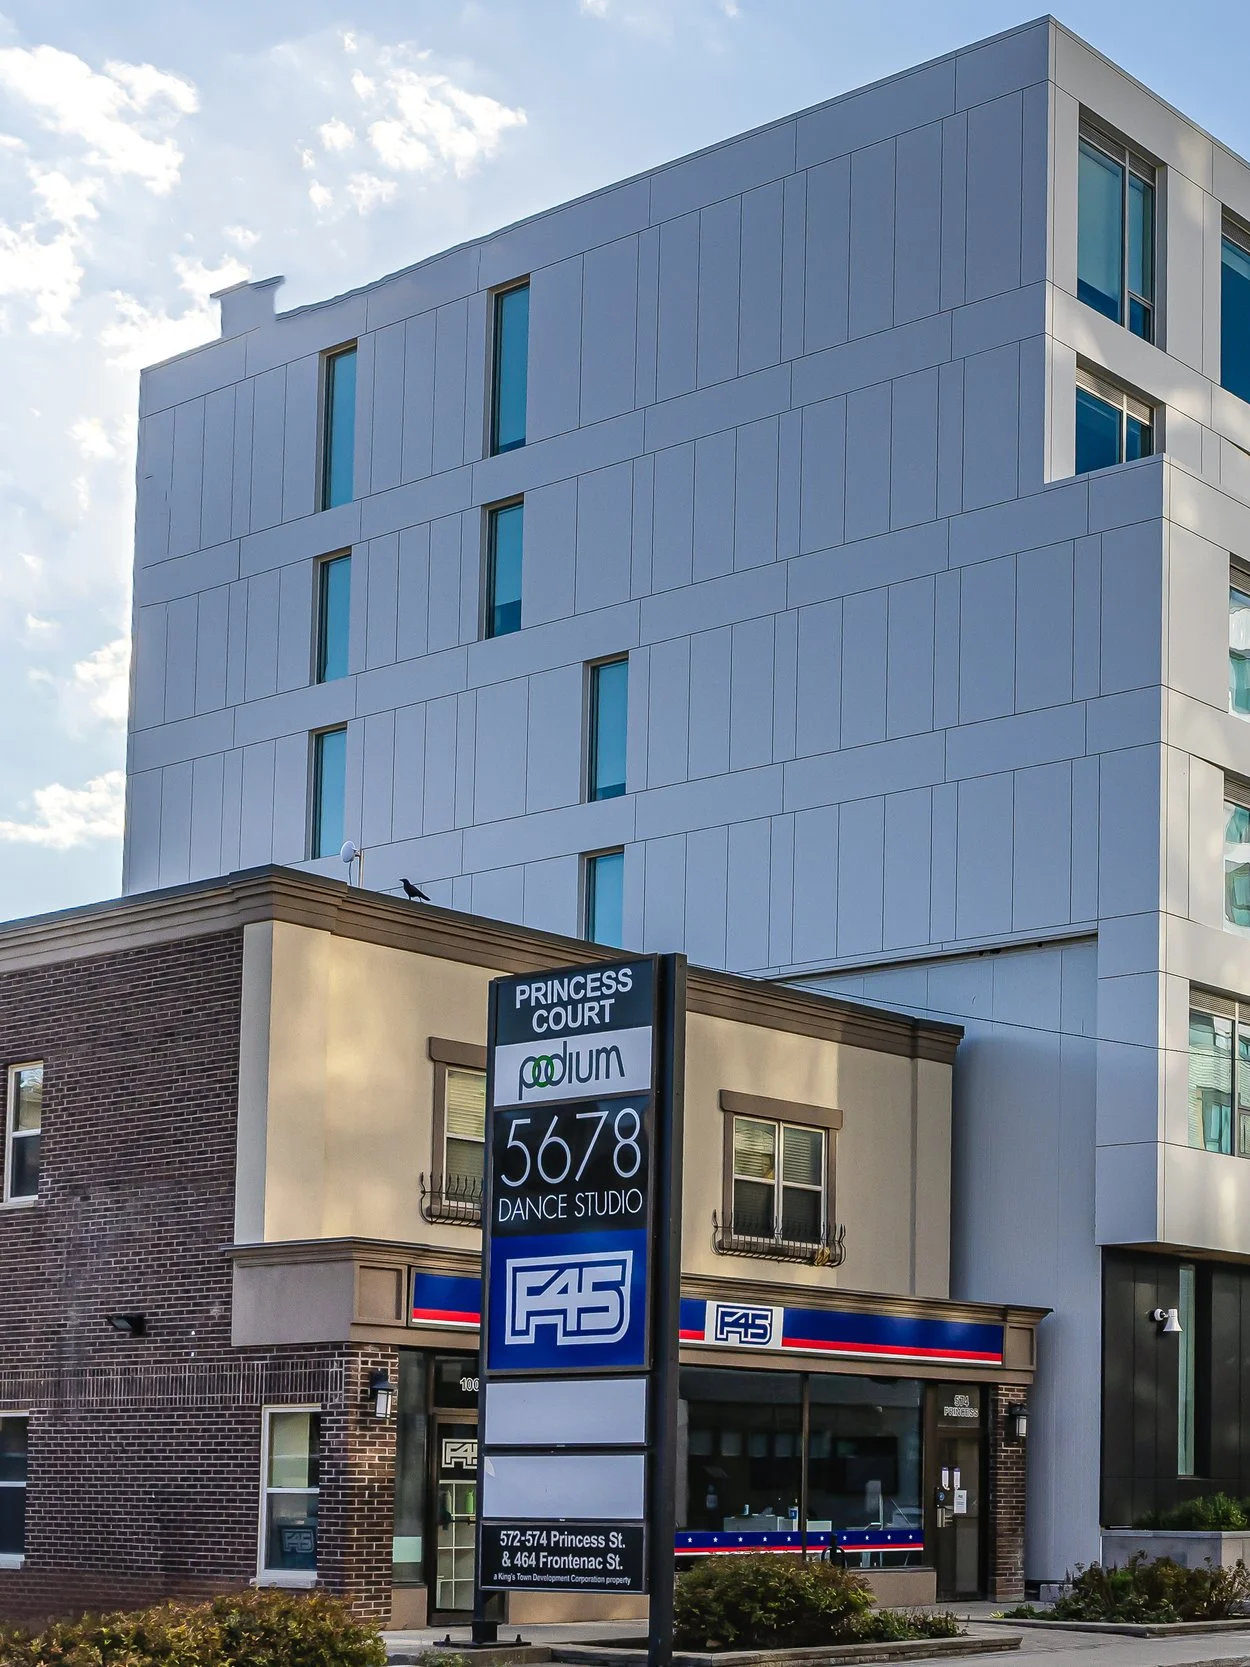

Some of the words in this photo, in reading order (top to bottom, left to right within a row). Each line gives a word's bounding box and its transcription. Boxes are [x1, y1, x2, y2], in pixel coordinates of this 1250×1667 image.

[515, 968, 633, 1009] PRINCESS
[532, 999, 615, 1033] COURT
[500, 1107, 641, 1187] 5678
[498, 1194, 567, 1222] DANCE
[574, 1188, 643, 1217] STUDIO
[505, 1250, 633, 1345] F45
[715, 1304, 773, 1345] F45
[500, 1530, 547, 1547] 572-574
[550, 1531, 606, 1548] Princess
[608, 1531, 626, 1549] St.
[501, 1551, 512, 1567] &
[513, 1551, 537, 1568] 464
[539, 1552, 604, 1569] Frontenac
[606, 1553, 624, 1570] St.
[498, 1572, 516, 1583] King's
[517, 1573, 532, 1581] Town
[532, 1573, 571, 1583] Development
[570, 1574, 606, 1584] Corporation
[605, 1576, 632, 1586] property
